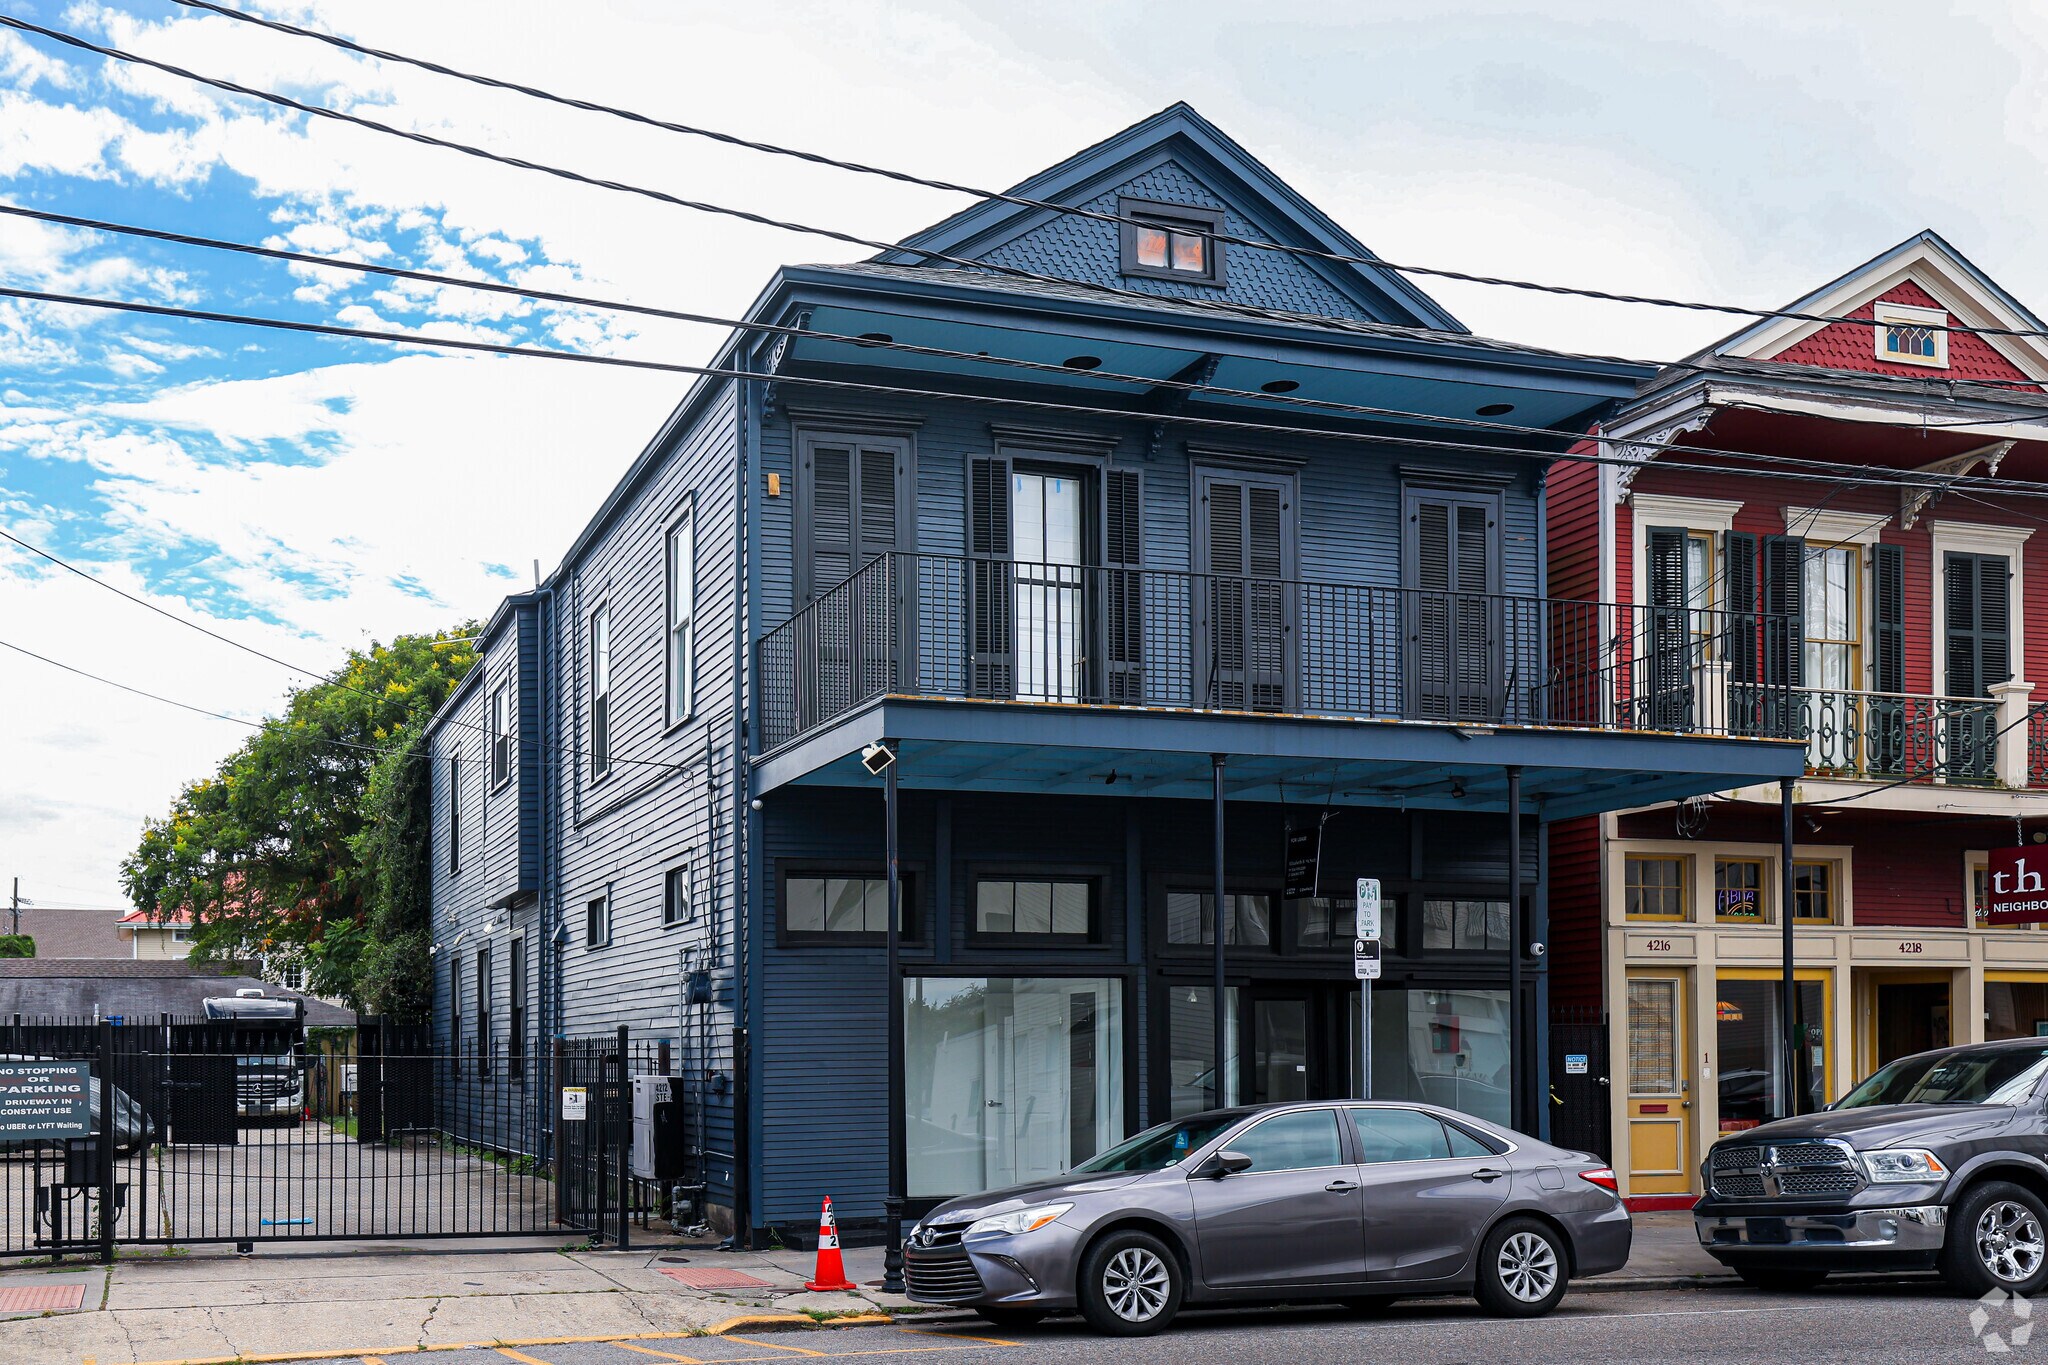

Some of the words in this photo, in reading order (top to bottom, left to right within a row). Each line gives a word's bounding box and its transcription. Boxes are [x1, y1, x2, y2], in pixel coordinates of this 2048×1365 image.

[1993, 858, 2046, 894] th
[1362, 901, 1373, 909] PAY
[1993, 900, 2048, 913] NEIGHBO
[1364, 910, 1371, 918] TO
[1646, 939, 1671, 952] 4216
[1898, 942, 1923, 954] 4218
[1703, 1052, 1709, 1064] 1
[17, 1067, 77, 1075] STOPPING
[0, 1085, 81, 1094] PARKING
[655, 1083, 668, 1092] 4212
[5, 1098, 59, 1106] DRIVEWAY
[0, 1107, 51, 1116] CONSTANT
[37, 1122, 56, 1130] LYFT
[56, 1122, 83, 1130] Waiting
